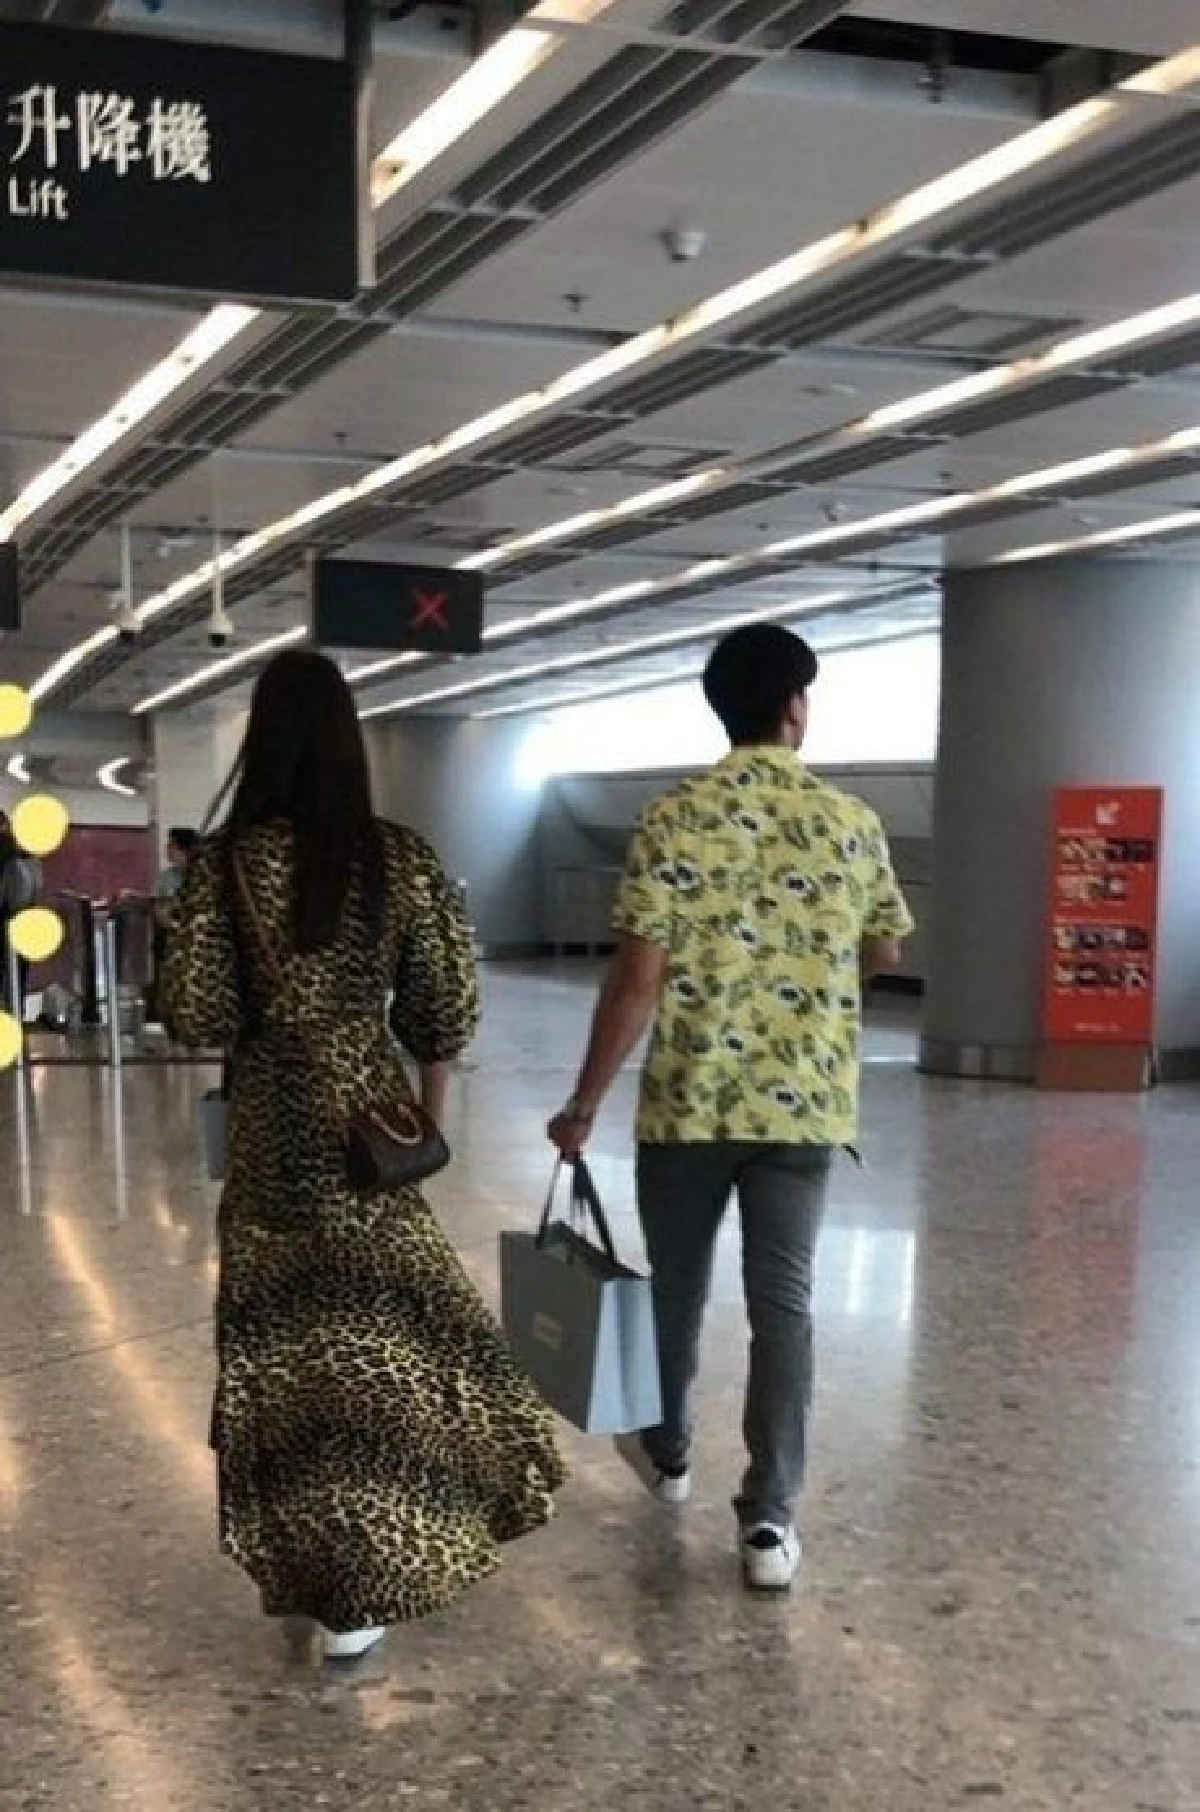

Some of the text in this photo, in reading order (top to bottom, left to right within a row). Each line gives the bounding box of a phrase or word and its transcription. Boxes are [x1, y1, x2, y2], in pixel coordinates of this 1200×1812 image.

[7, 83, 211, 182] 升降機
[9, 175, 68, 220] Lift
